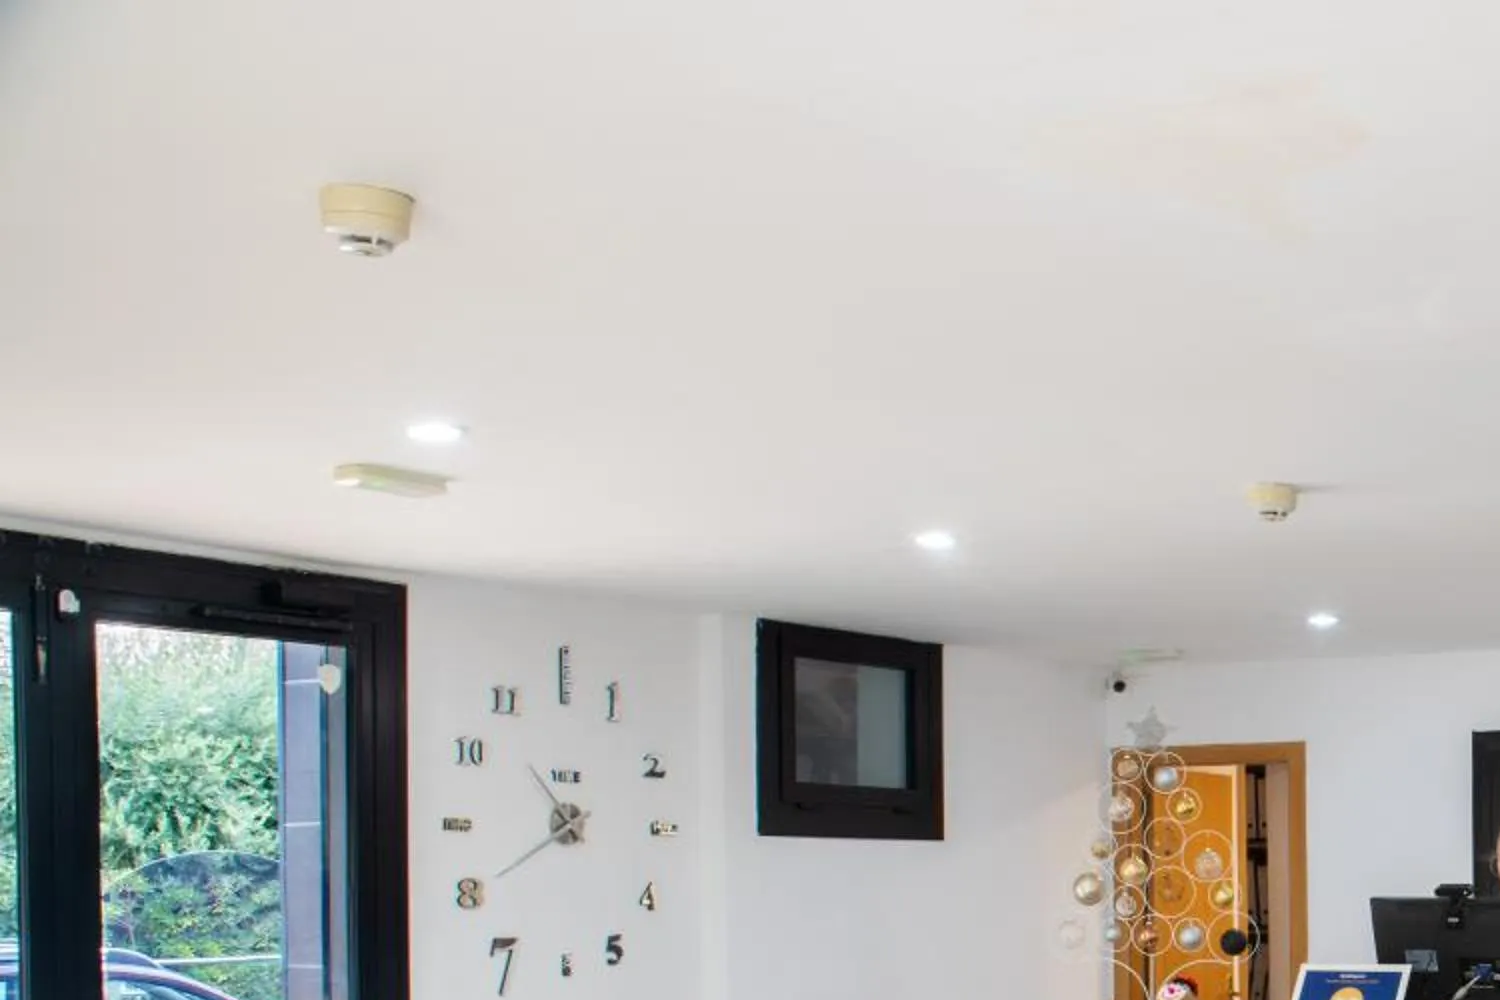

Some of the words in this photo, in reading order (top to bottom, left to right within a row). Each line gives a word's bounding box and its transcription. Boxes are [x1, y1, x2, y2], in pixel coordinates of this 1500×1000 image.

[491, 685, 520, 717] 11
[605, 681, 621, 723] 1
[454, 735, 485, 767] 10
[642, 753, 667, 780] 2
[455, 877, 484, 910] 8
[638, 881, 657, 911] 4
[605, 933, 625, 967] 5
[488, 936, 520, 997] 7
